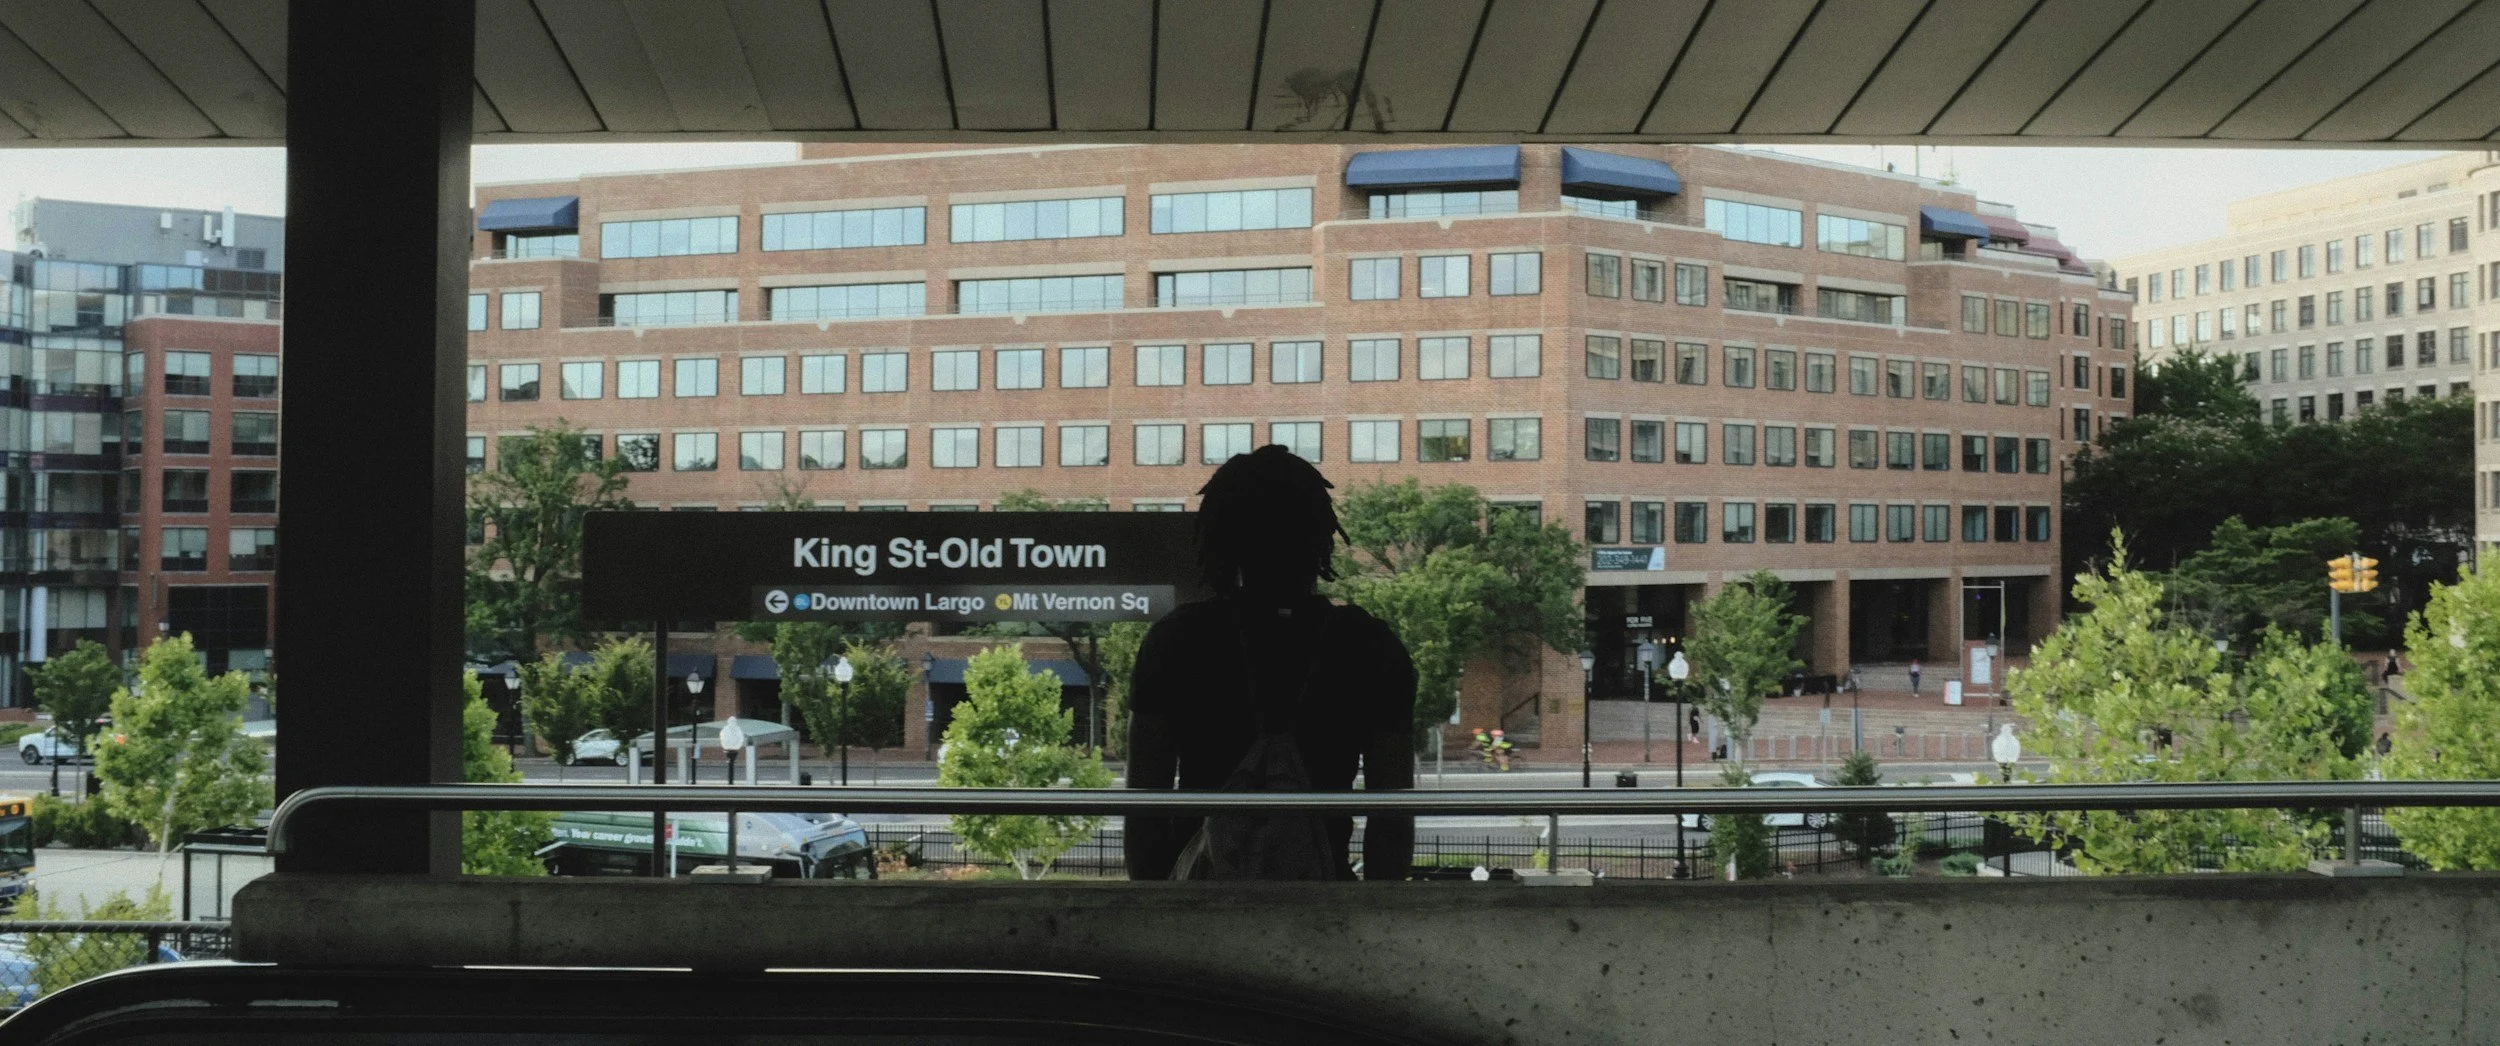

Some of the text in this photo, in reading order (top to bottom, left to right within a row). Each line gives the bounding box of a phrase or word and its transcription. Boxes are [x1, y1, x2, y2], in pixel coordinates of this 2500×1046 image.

[794, 538, 1106, 575] King St-Old Town
[811, 593, 985, 614] Downtown Largo
[1013, 592, 1149, 614] Mt Vernon Sq
[571, 828, 592, 839] Your
[592, 832, 623, 841] career
